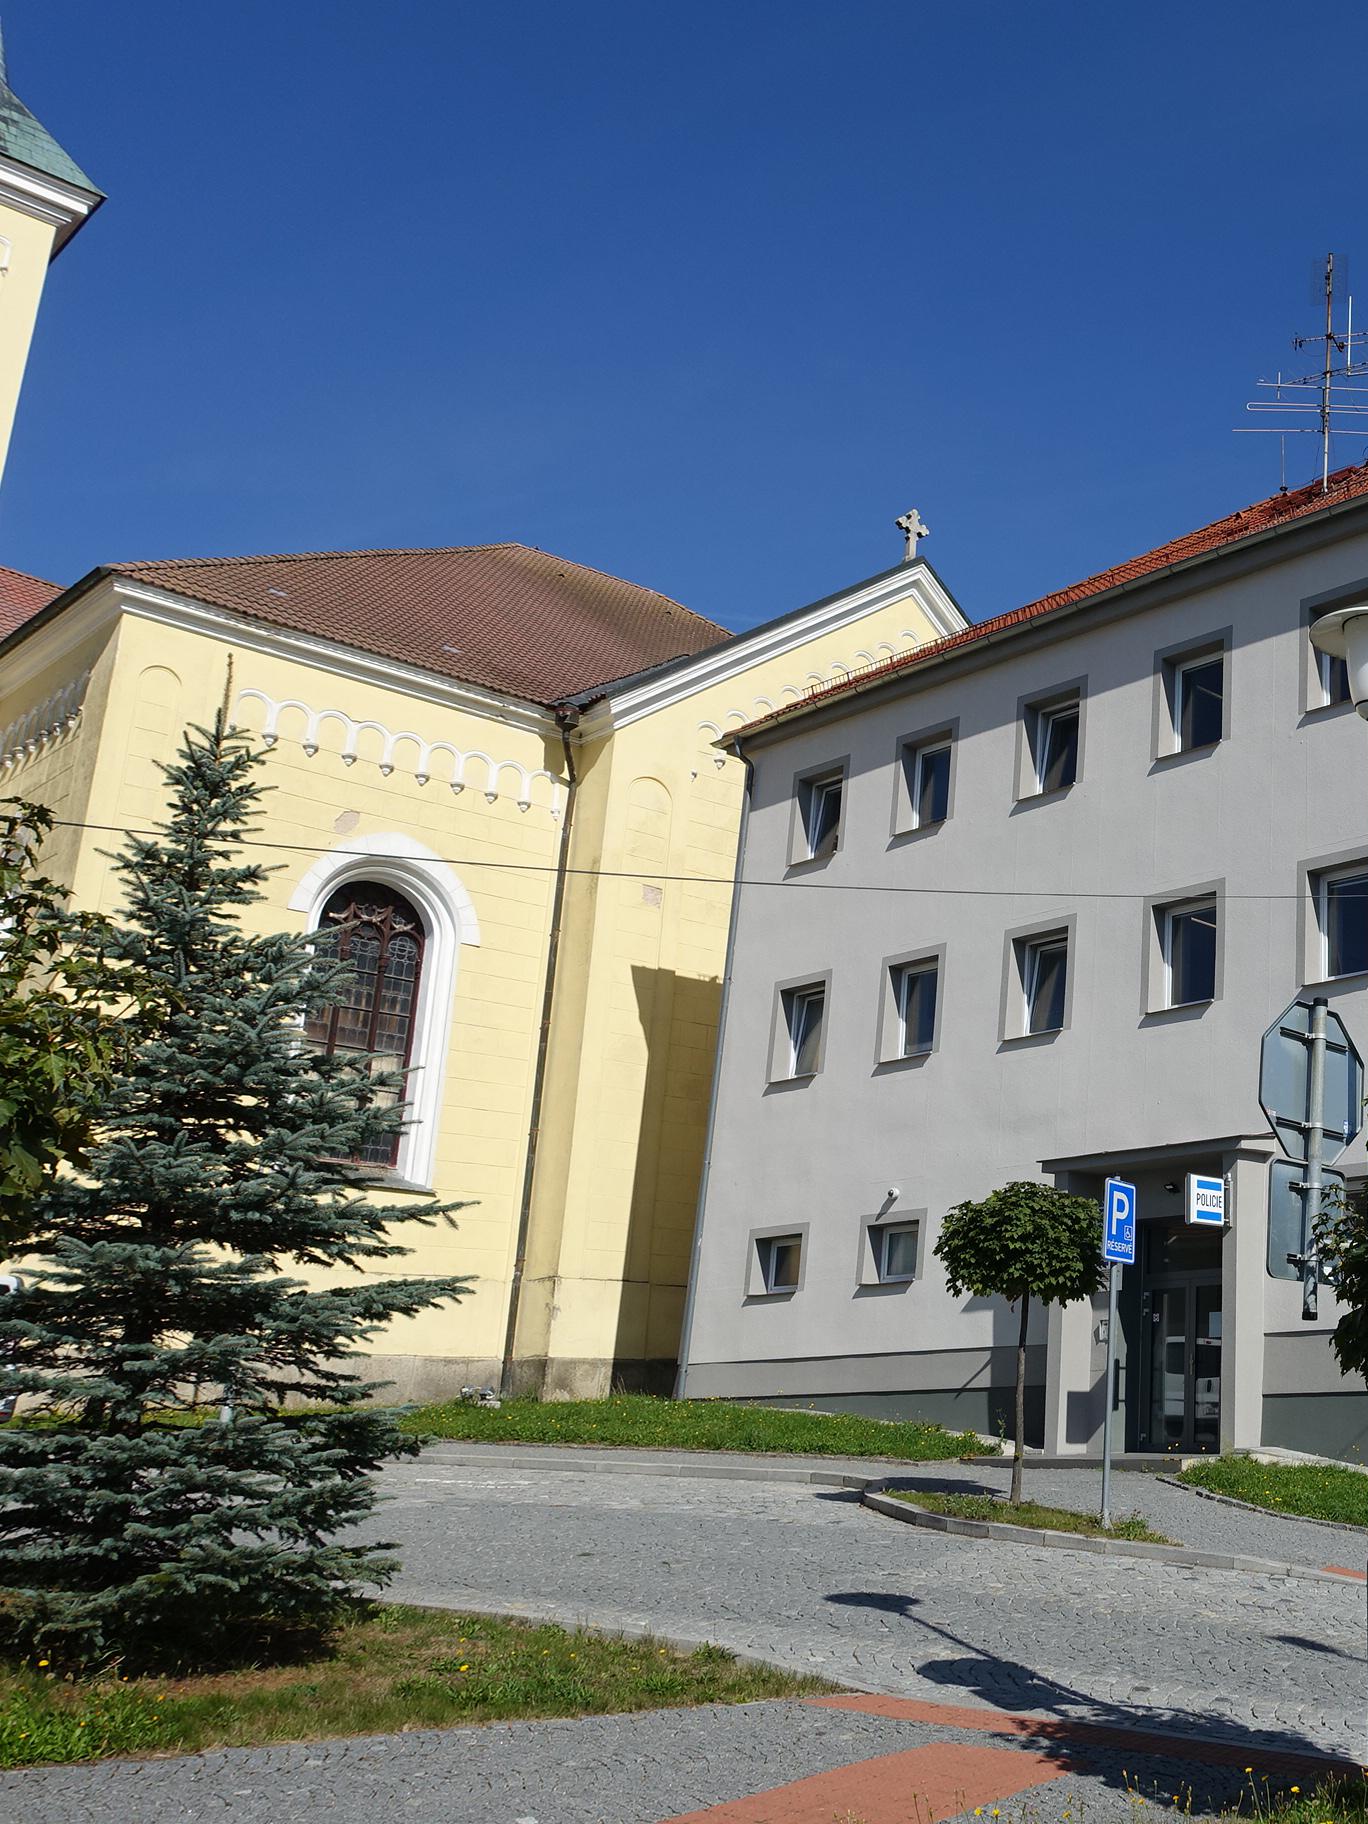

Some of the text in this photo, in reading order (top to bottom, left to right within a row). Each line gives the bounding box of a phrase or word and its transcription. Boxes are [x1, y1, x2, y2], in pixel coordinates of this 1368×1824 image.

[1196, 1192, 1223, 1209] POLICIE
[1112, 1190, 1130, 1235] P
[1106, 1238, 1133, 1254] RÉSERVÉ
